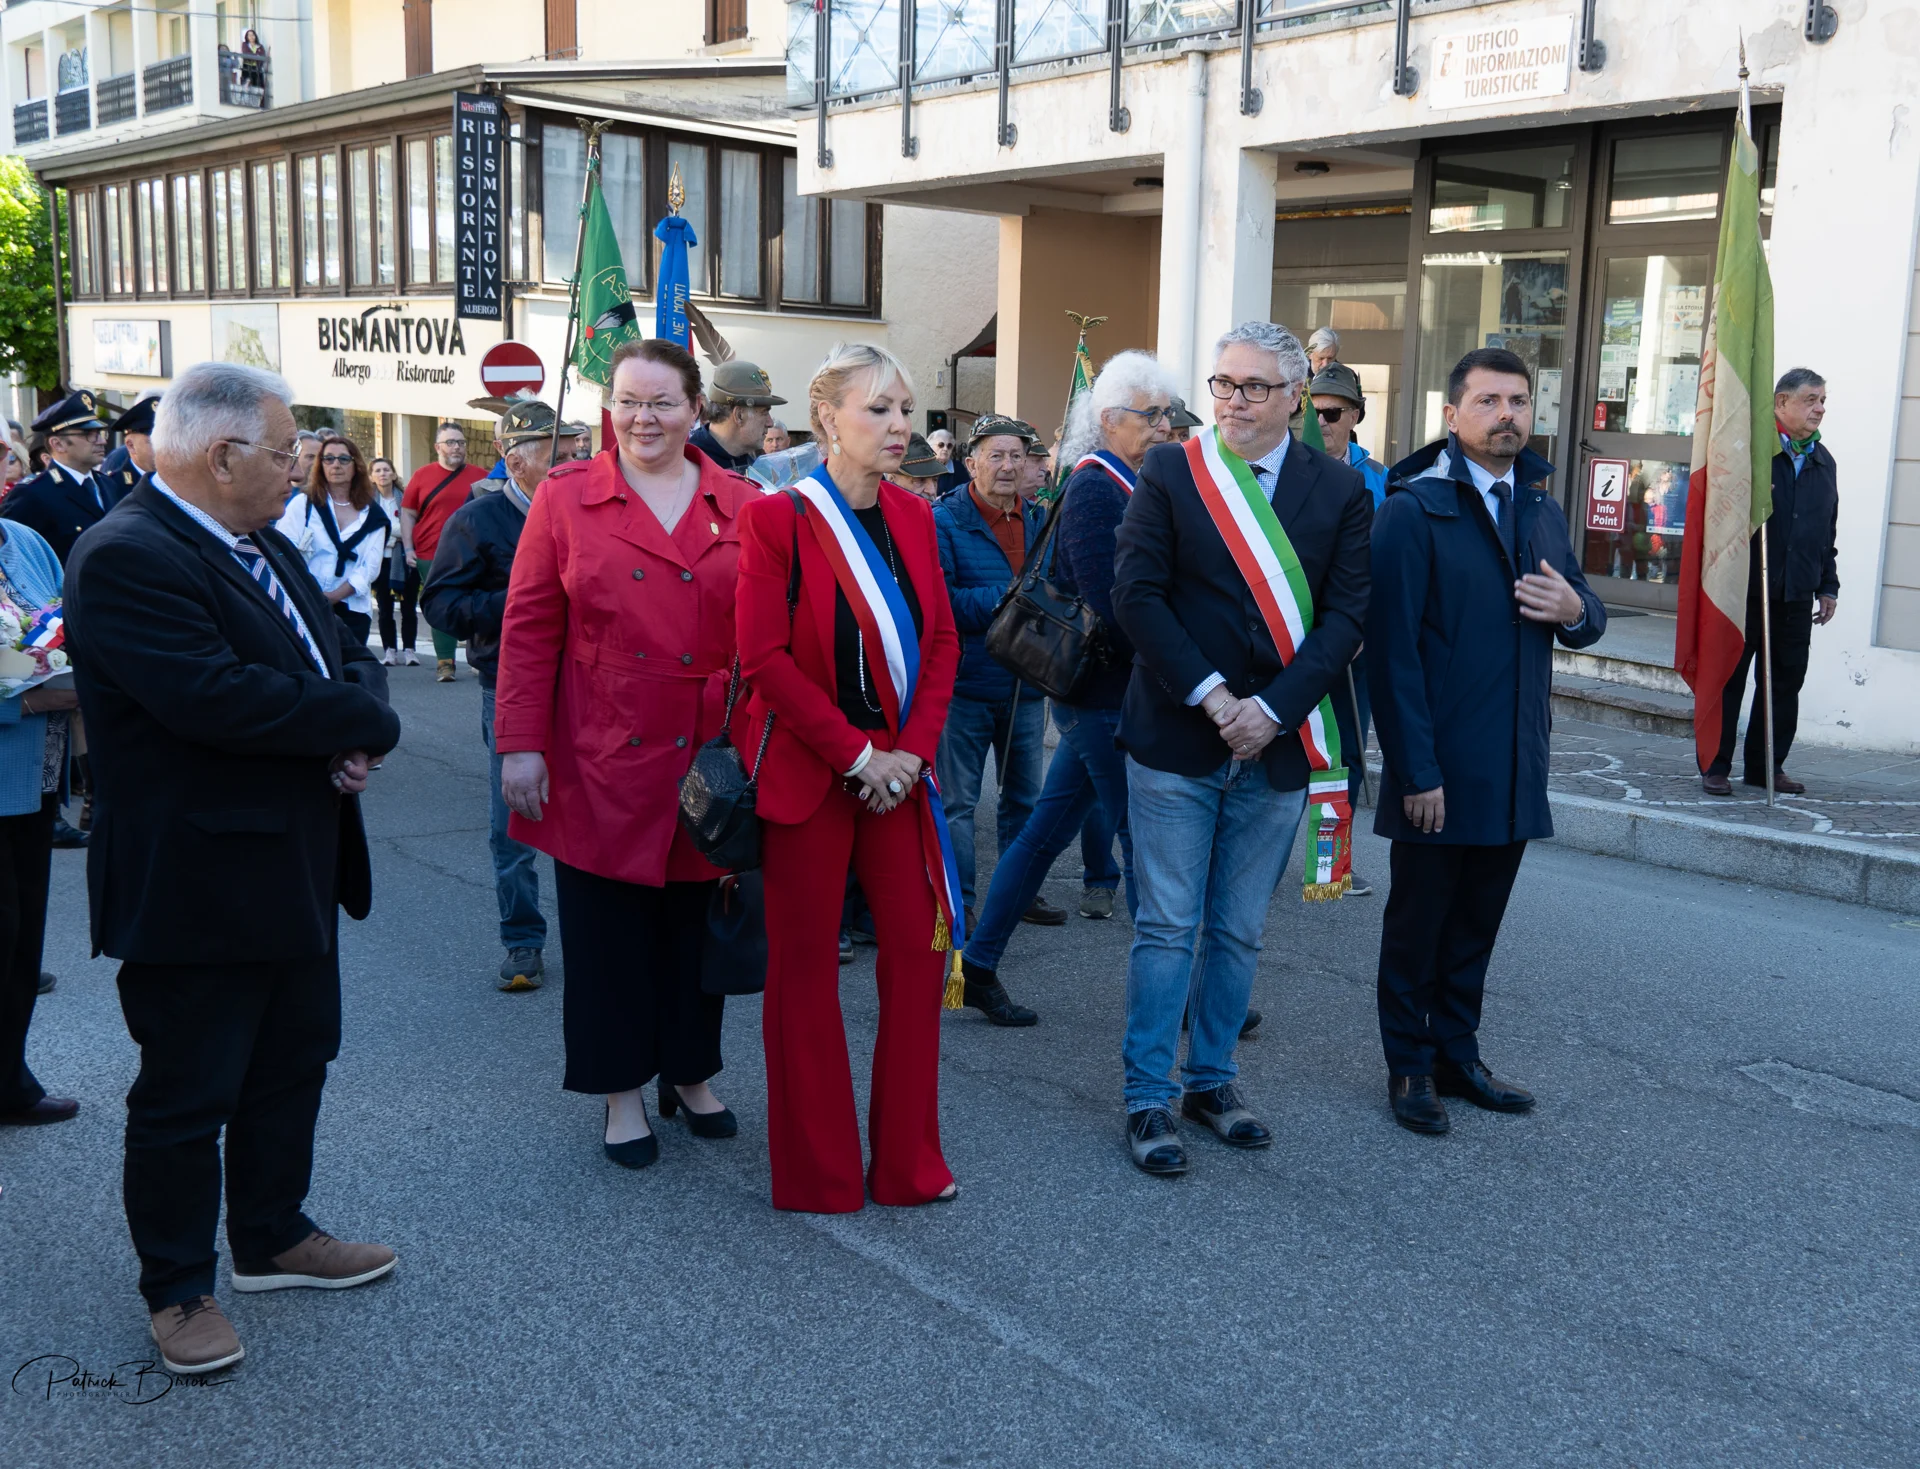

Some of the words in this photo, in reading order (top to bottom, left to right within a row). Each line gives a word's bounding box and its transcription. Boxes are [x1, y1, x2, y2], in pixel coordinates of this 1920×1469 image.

[1467, 28, 1519, 53] UFFICIO
[1465, 44, 1566, 76] INFORMAZIONI
[1464, 71, 1539, 98] TURISTICHE
[462, 118, 476, 298] RISTORANTE
[483, 120, 498, 300] BISMANTOVA
[463, 304, 498, 315] ALBERGO
[673, 283, 687, 315] MONTI
[318, 317, 467, 356] BISMANTOVA
[332, 358, 371, 385] Albergo
[396, 360, 456, 386] Ristorante
[1593, 515, 1618, 527] Point
[1597, 503, 1616, 514] Info
